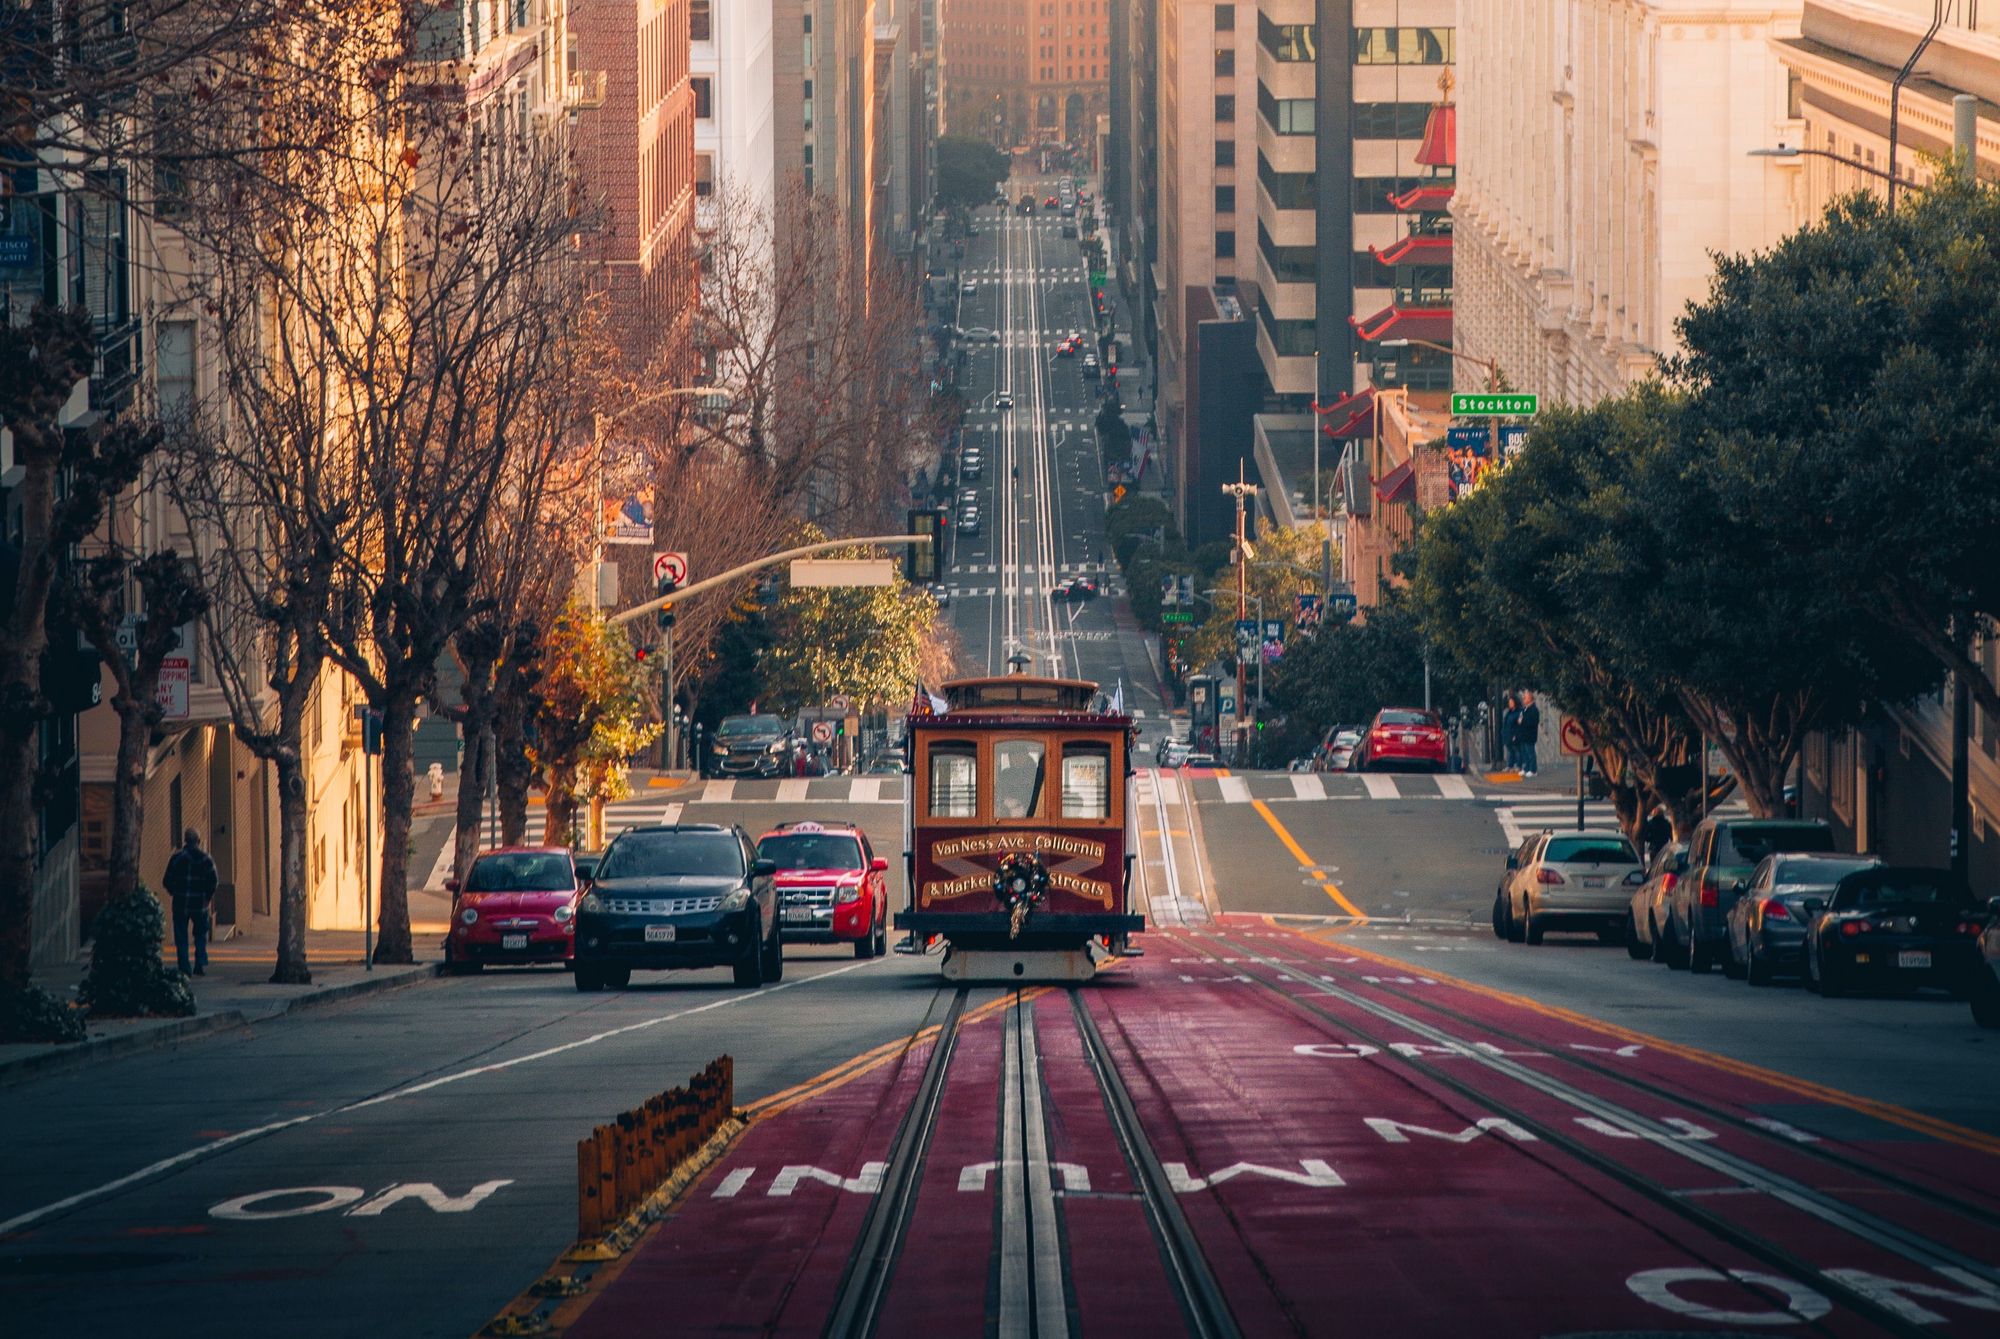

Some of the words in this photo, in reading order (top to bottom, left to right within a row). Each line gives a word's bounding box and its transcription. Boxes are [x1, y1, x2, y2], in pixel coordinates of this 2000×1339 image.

[1459, 398, 1531, 411] Stockton
[162, 658, 184, 668] AWAY
[160, 670, 186, 682] TOPPING
[161, 683, 173, 694] NY
[158, 695, 173, 705] IME
[936, 842, 959, 857] Van
[961, 838, 994, 852] Ness
[1035, 835, 1103, 858] California
[930, 884, 940, 896] &
[942, 875, 992, 896] Market
[1049, 872, 1105, 897] Streets
[1293, 1042, 1645, 1058] ONLY
